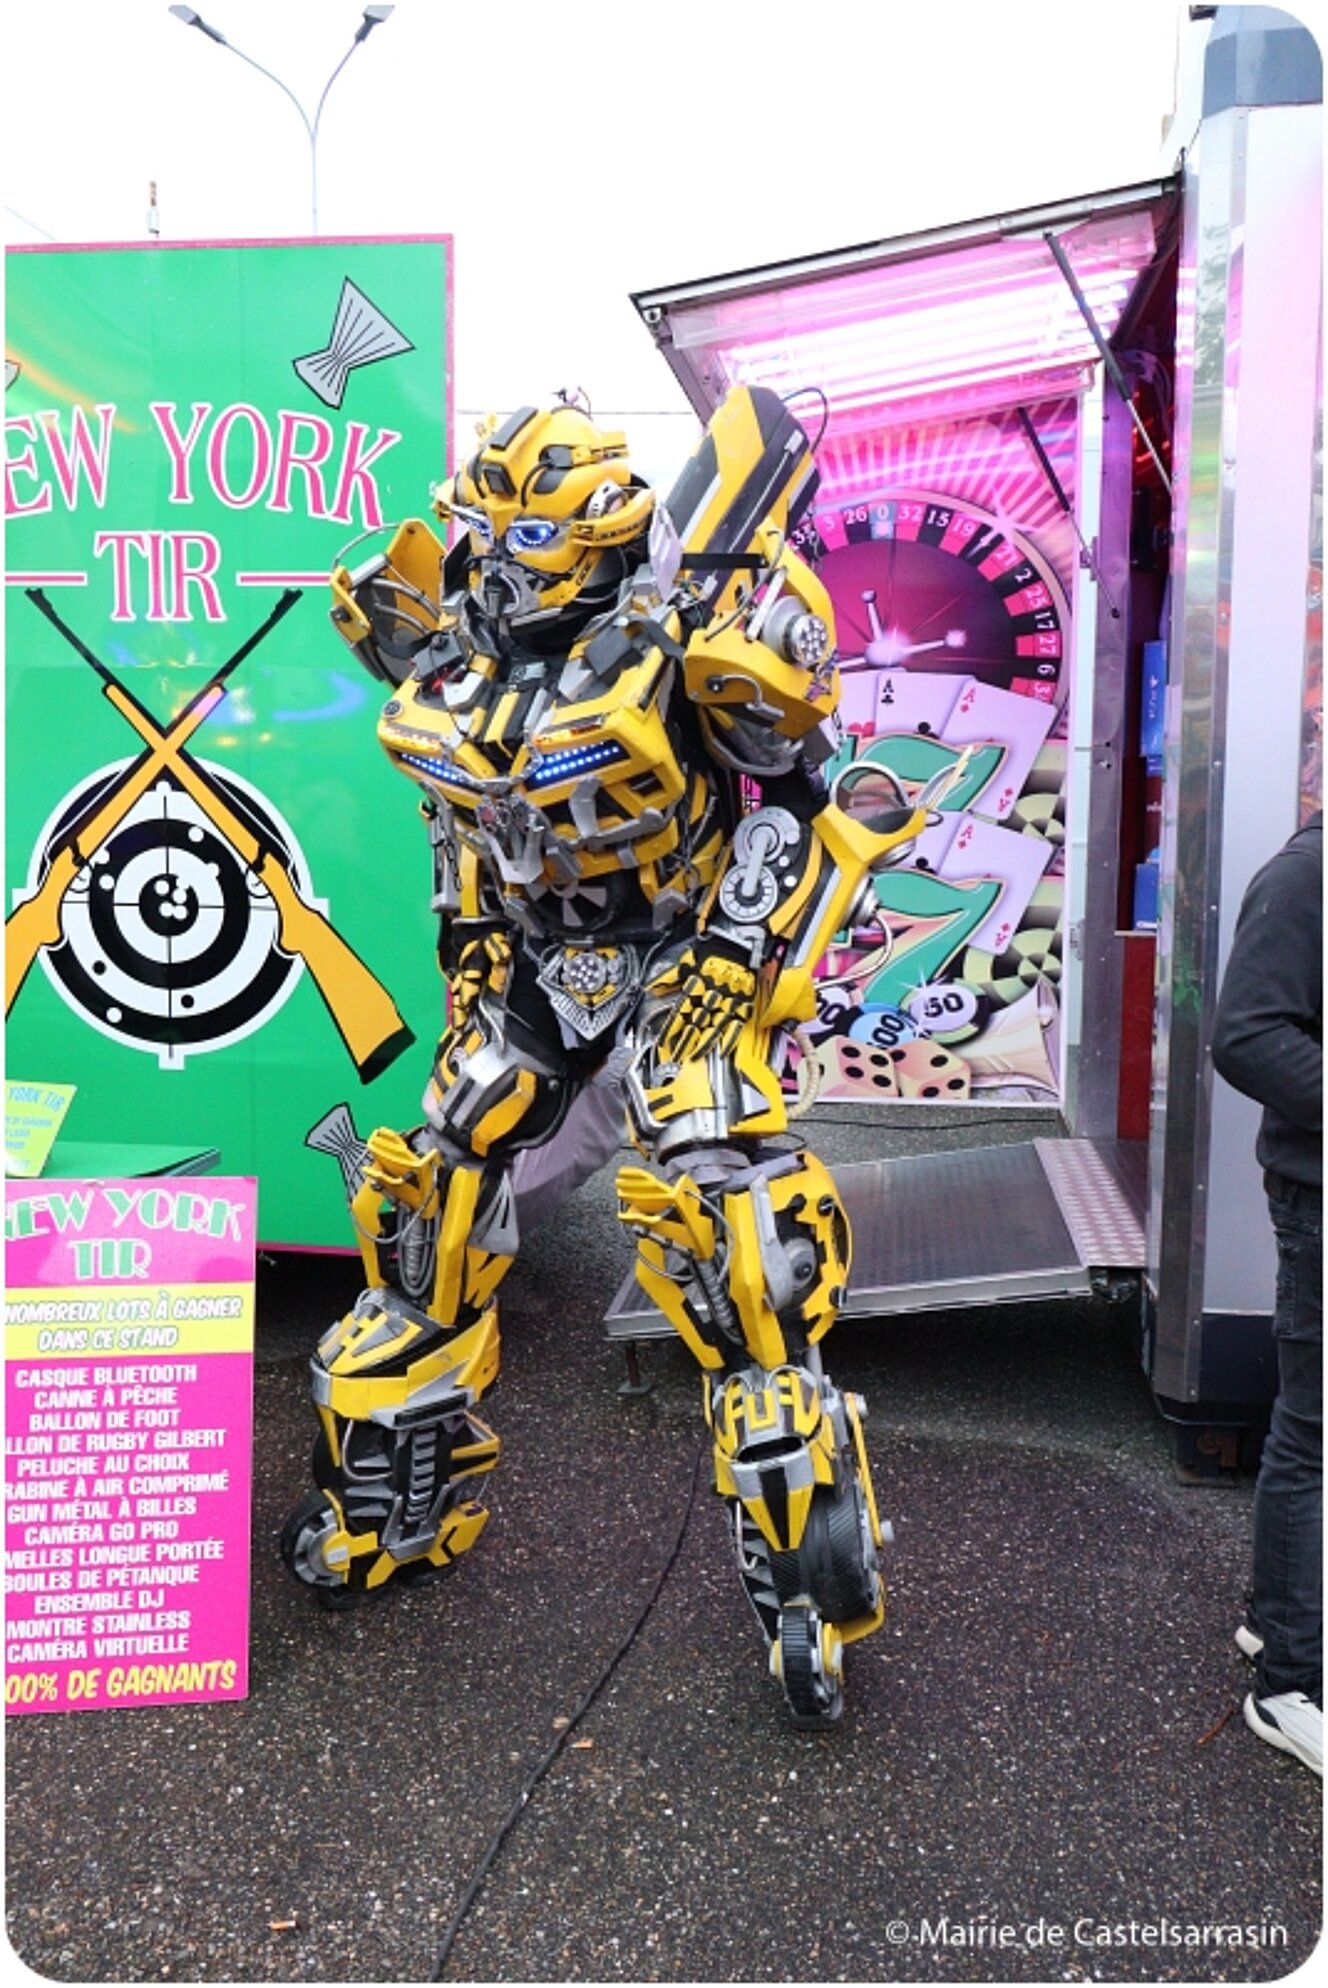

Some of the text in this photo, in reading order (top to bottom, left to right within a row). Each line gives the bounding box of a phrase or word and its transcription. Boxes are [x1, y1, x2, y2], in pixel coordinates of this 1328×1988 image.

[149, 402, 402, 530] YORK
[877, 505, 889, 520] 0
[898, 505, 922, 522] 32
[927, 510, 950, 527] 15
[952, 517, 976, 537] 19
[93, 530, 227, 622] TIR
[1015, 567, 1032, 583] 2
[1035, 611, 1056, 630] 17
[925, 992, 964, 1019] 50
[867, 1013, 905, 1049] 00
[102, 1188, 246, 1242] YORK
[67, 1238, 152, 1279] TIR
[107, 1298, 151, 1321] LOTS
[173, 1297, 242, 1319] GAGNER
[38, 1327, 178, 1351] DANS CE STAND
[16, 1365, 197, 1388] CASQUE BLUETOOTH
[35, 1390, 96, 1409] CANNE
[121, 1385, 177, 1405] PÊCHE
[30, 1409, 180, 1431] BALLON DE FOOT
[58, 1435, 80, 1453] DE
[87, 1432, 148, 1450] RUGBY
[155, 1429, 226, 1449] GILBERT
[18, 1453, 189, 1477] PELUCHE AU CHOIX
[93, 1478, 123, 1496] AIR
[129, 1469, 228, 1494] COMPRIMÉ
[8, 1504, 46, 1524] GUN
[53, 1499, 111, 1521] MÉTAL
[137, 1497, 196, 1517] BILLES
[25, 1521, 179, 1546] CAMÉRA GO PRO
[79, 1545, 150, 1565] LONGUE
[156, 1537, 223, 1561] PORTÉE
[78, 1571, 101, 1588] DE
[107, 1564, 199, 1587] PÉTANQUE
[35, 1590, 164, 1614] ENSEMBLE DJ
[7, 1611, 190, 1639] MONTRE STAINLESS
[8, 1634, 189, 1663] CAMÉRA VIRTUELLE
[67, 1669, 100, 1699] DE
[107, 1661, 237, 1697] GAGNANTS
